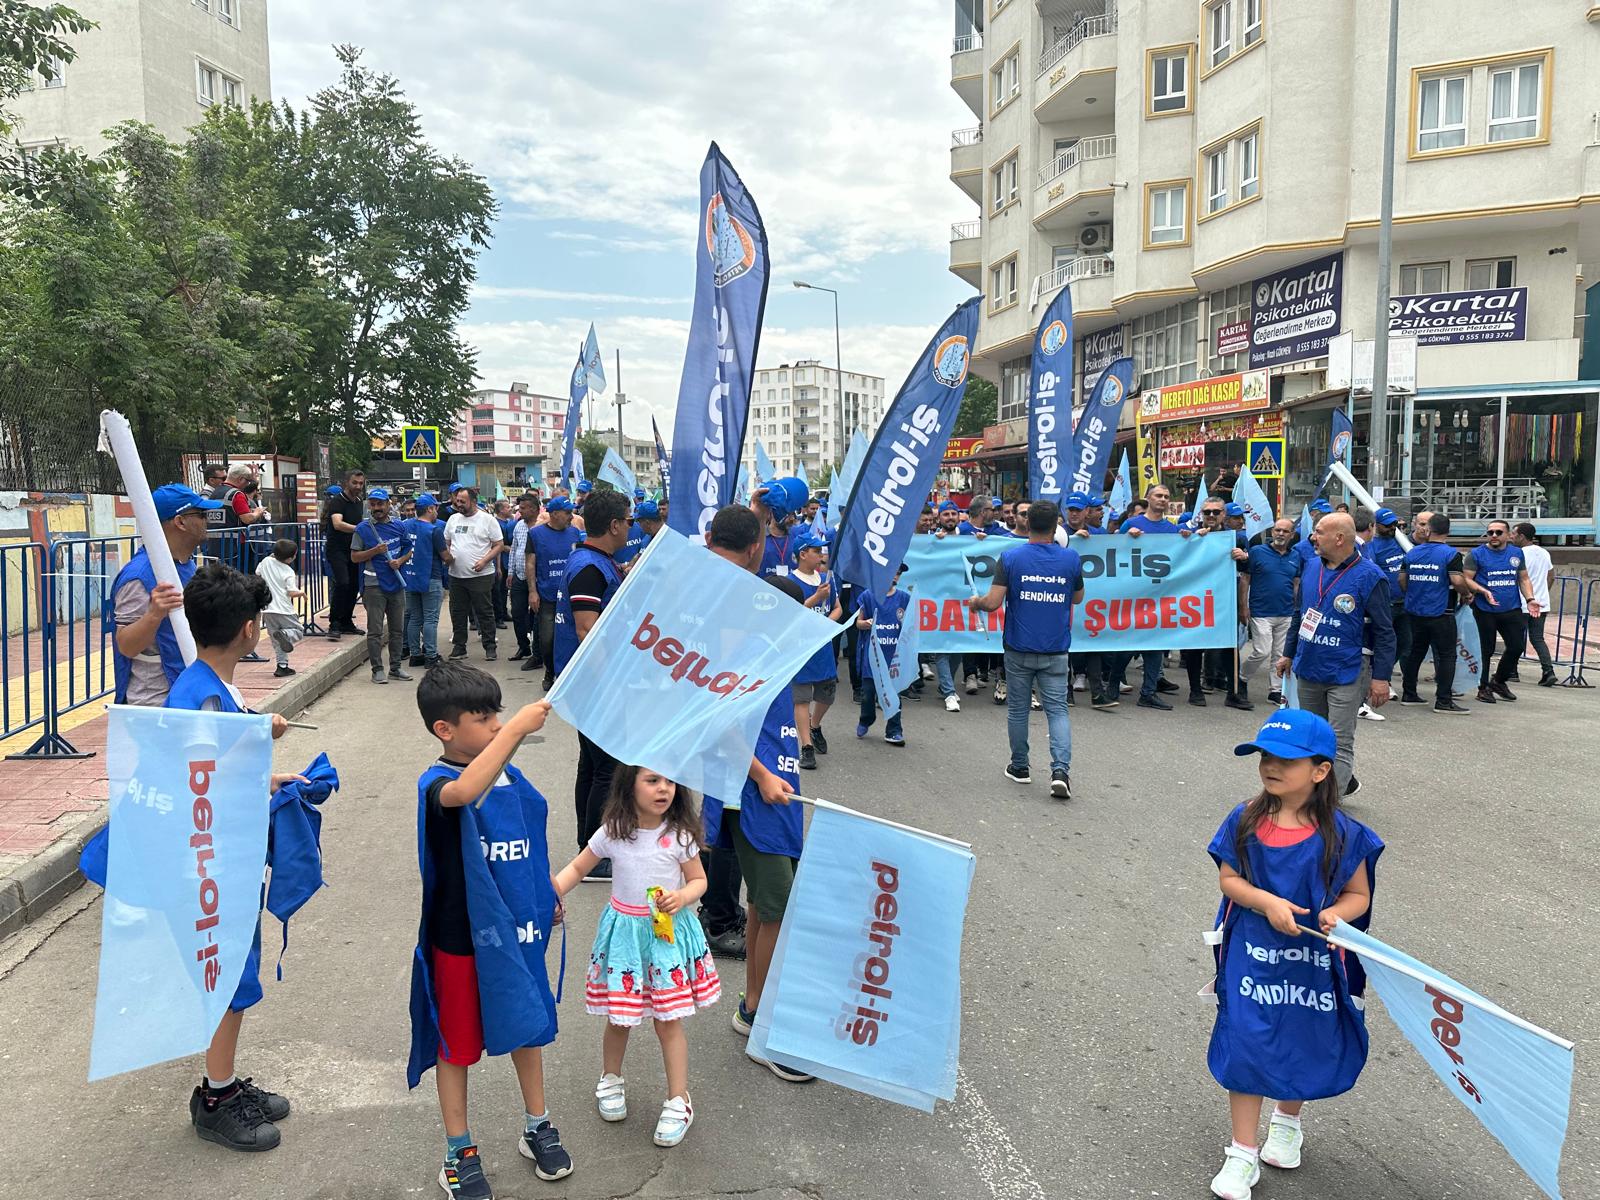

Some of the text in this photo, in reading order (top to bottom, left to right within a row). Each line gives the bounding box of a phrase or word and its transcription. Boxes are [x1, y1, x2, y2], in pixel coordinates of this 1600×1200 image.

[1269, 261, 1337, 305] Kartal
[1254, 292, 1334, 326] Psikoteknik
[1404, 290, 1521, 315] Kartal
[1220, 324, 1247, 337] KARTAL
[1255, 313, 1333, 342] Değerlendirme Merkezi
[1388, 311, 1517, 330] Psikoteknik
[1092, 325, 1124, 354] Kartal
[1161, 380, 1240, 411] MERETO DAĞ KASAP
[1035, 371, 1061, 495] petrol-iş
[1072, 416, 1107, 496] etrol-iş
[862, 404, 940, 567] petrol-iş
[1021, 575, 1066, 585] petrol-iş
[1409, 574, 1439, 583] SENDİKASI
[1020, 590, 1065, 603] SENDİKASI
[1084, 590, 1215, 638] ŞUBESİ
[845, 861, 902, 1047] petrol-iş
